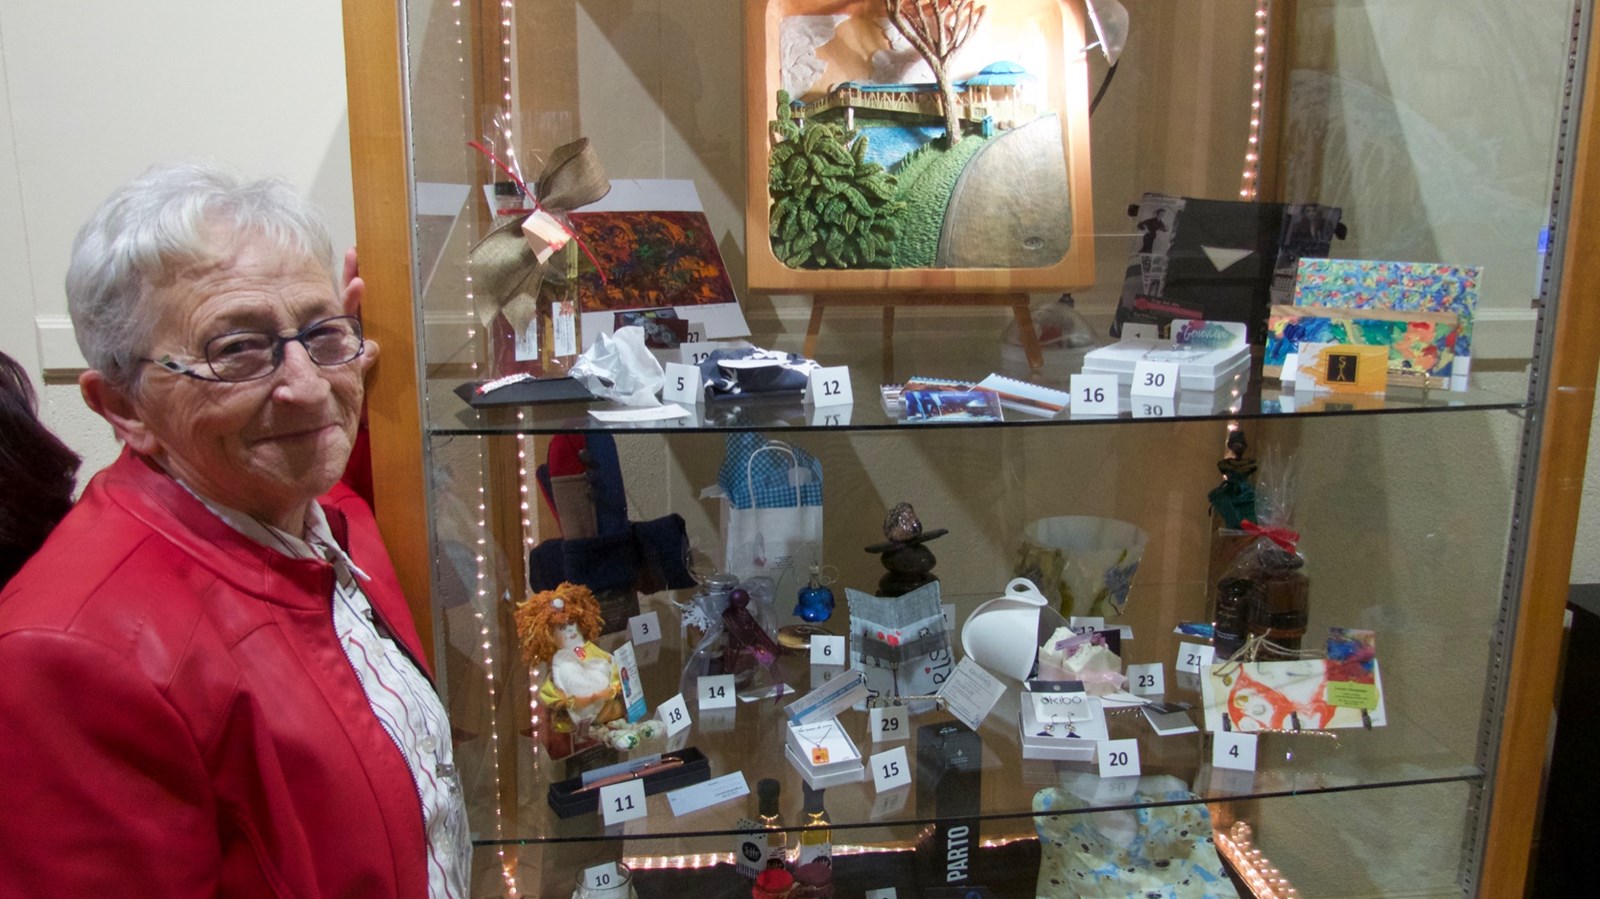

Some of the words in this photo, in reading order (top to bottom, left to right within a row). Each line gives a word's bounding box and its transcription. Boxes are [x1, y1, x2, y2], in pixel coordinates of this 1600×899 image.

[687, 331, 699, 343] 27
[676, 376, 684, 391] 5
[1143, 373, 1165, 387] 30
[823, 380, 841, 396] 12
[1083, 388, 1104, 403] 16
[641, 623, 649, 634] 3
[823, 645, 832, 656] 6
[1186, 653, 1202, 667] 21
[1138, 674, 1155, 688] 23
[708, 686, 725, 699] 14
[668, 707, 682, 724] 18
[881, 717, 899, 732] 29
[1109, 751, 1128, 766] 20
[1229, 745, 1239, 758] 4
[882, 761, 899, 779] 15
[614, 795, 635, 813] 11
[946, 825, 970, 883] PARTO
[595, 873, 610, 887] 10
